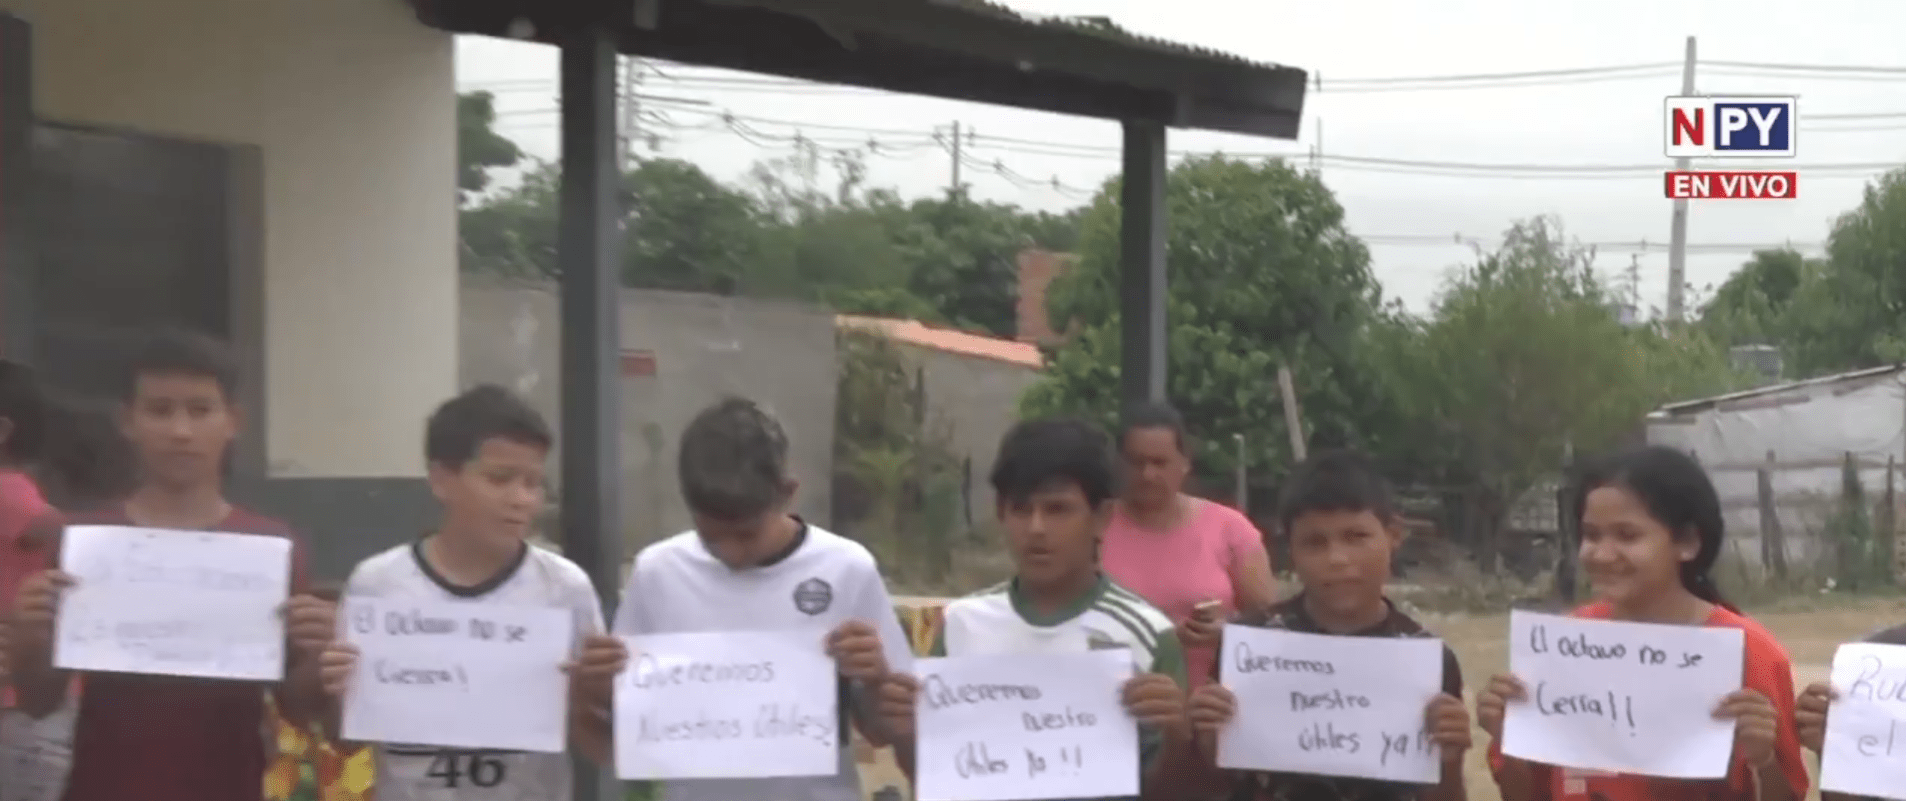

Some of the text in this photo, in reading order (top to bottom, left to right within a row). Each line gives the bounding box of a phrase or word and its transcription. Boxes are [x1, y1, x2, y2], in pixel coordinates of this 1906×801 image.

[1234, 642, 1335, 674] Queremos
[1639, 645, 1667, 665] no
[1676, 652, 1703, 669] se
[426, 750, 506, 788] 46
